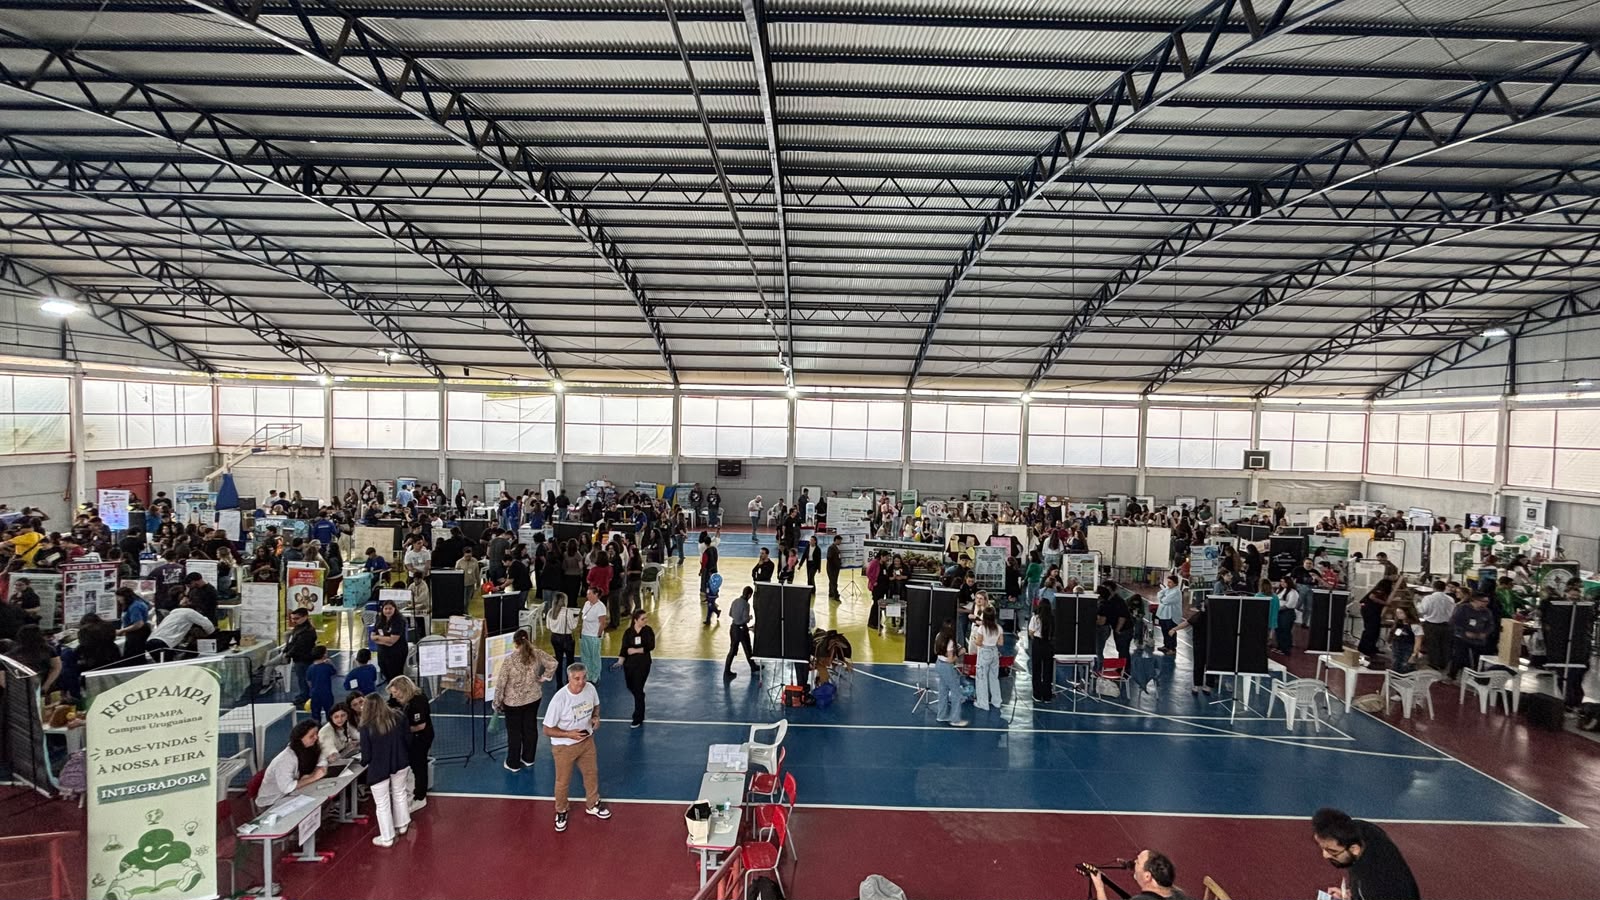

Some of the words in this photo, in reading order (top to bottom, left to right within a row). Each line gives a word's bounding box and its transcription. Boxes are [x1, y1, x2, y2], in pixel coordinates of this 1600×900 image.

[101, 686, 211, 719] FECIPAMPA
[108, 725, 147, 735] Campus
[149, 715, 202, 728] Uruguaiana
[126, 709, 183, 722] UNIPAMPA
[105, 735, 198, 757] BOAS-VINDAS
[98, 764, 107, 775] À
[111, 758, 160, 773] NOSSA
[164, 750, 205, 764] FEIRA
[101, 773, 207, 798] INTEGRADORA
